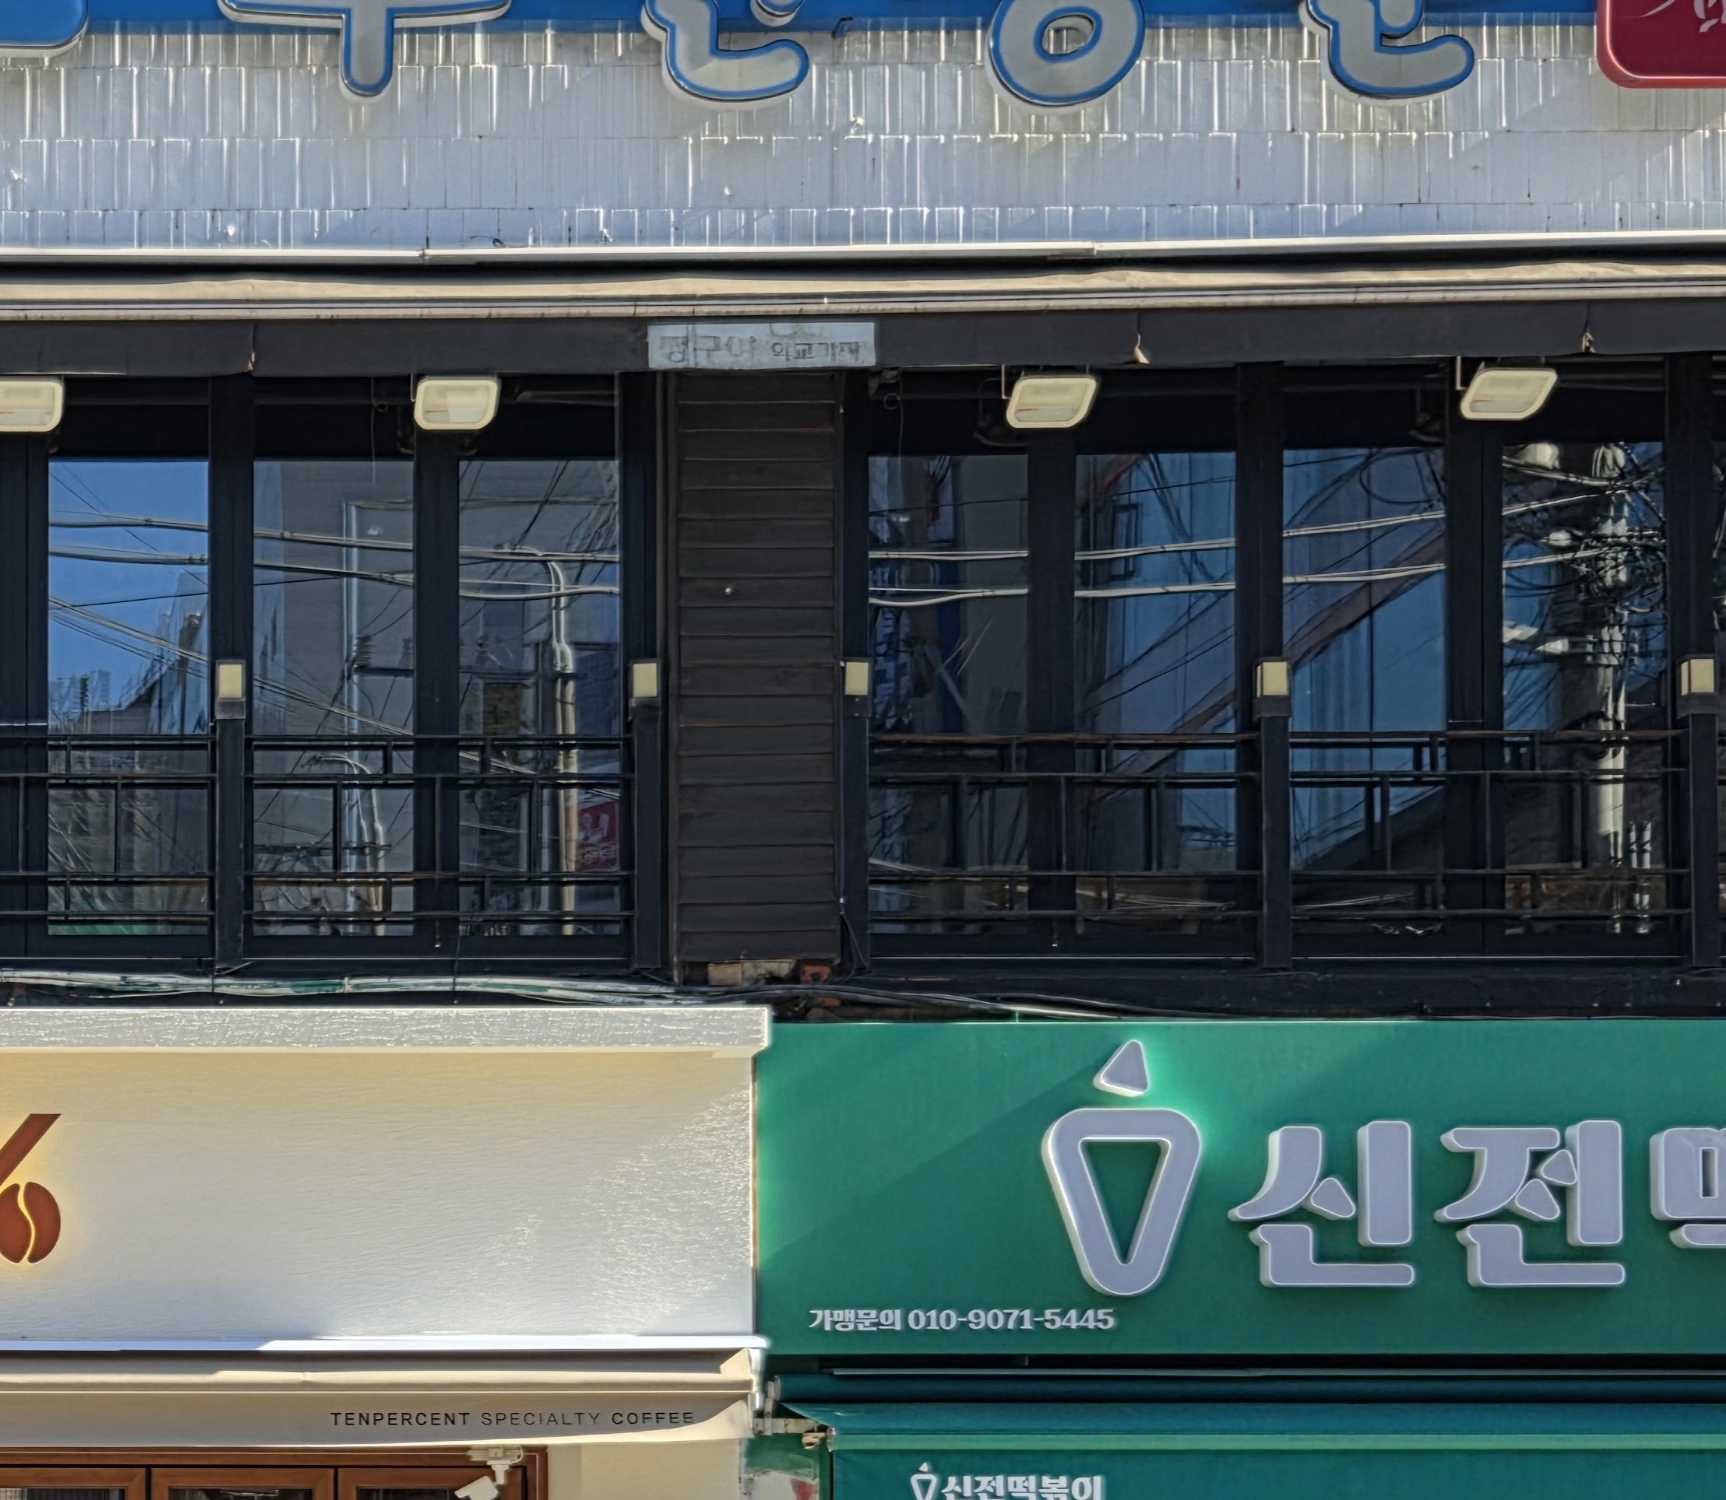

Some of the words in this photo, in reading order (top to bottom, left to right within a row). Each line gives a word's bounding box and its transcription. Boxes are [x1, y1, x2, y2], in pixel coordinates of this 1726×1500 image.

[809, 1307, 902, 1333] 가맹문의
[908, 1308, 1116, 1332] 010-9071-5445
[330, 1412, 471, 1426] TENPERCENT
[481, 1412, 601, 1426] SPECIALTY
[611, 1411, 695, 1425] COFFEE
